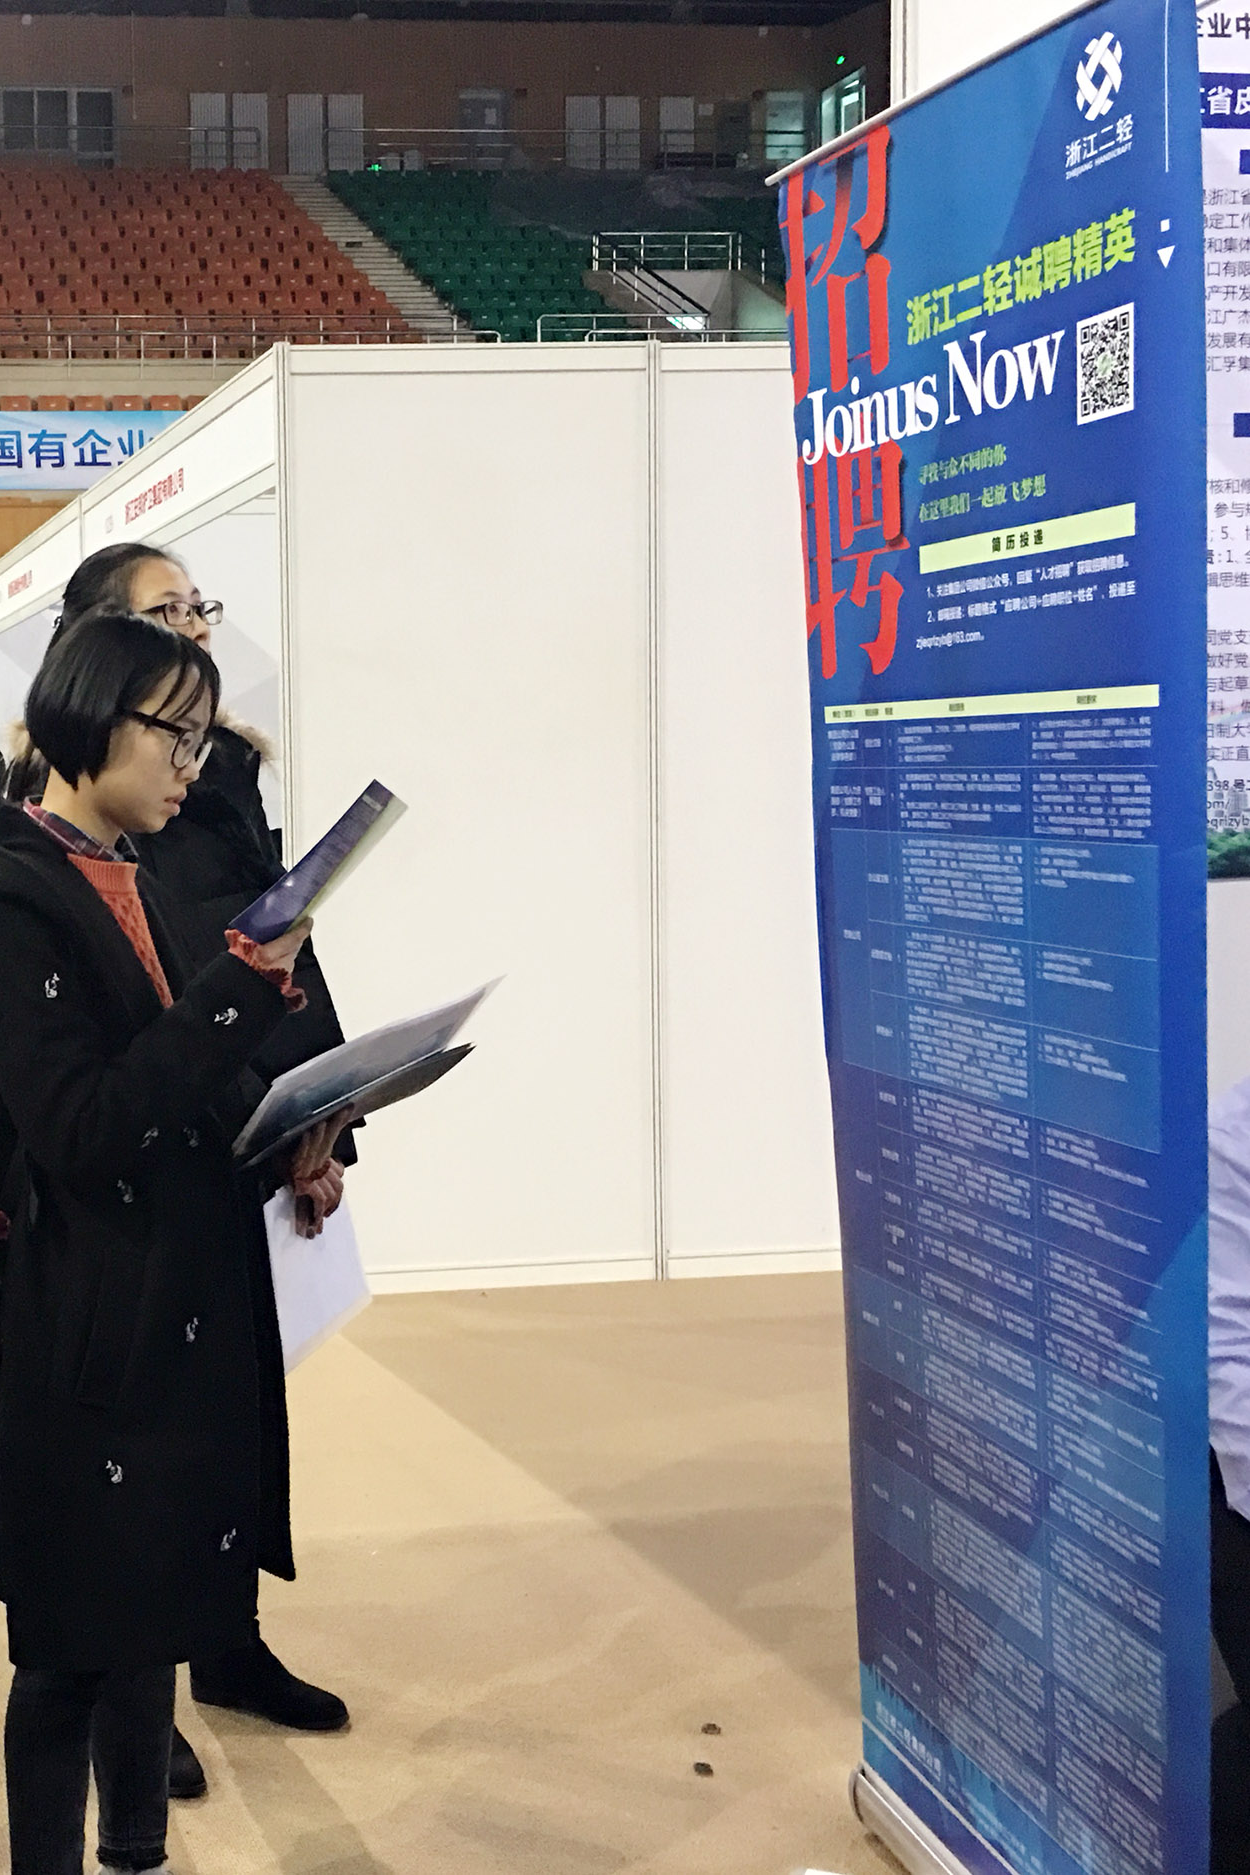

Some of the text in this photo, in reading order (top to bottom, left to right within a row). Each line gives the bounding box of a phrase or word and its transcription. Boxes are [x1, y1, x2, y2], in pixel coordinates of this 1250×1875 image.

[1199, 86, 1250, 116] 省皮
[1065, 113, 1134, 168] 浙江二轻
[1203, 188, 1250, 206] 浙江省
[1203, 213, 1250, 230] 定工作
[1204, 237, 1250, 254] 和集体
[906, 206, 1136, 346] 浙江二轻诚聘精英
[943, 329, 1065, 425] Now
[992, 529, 1043, 553] 简历投递
